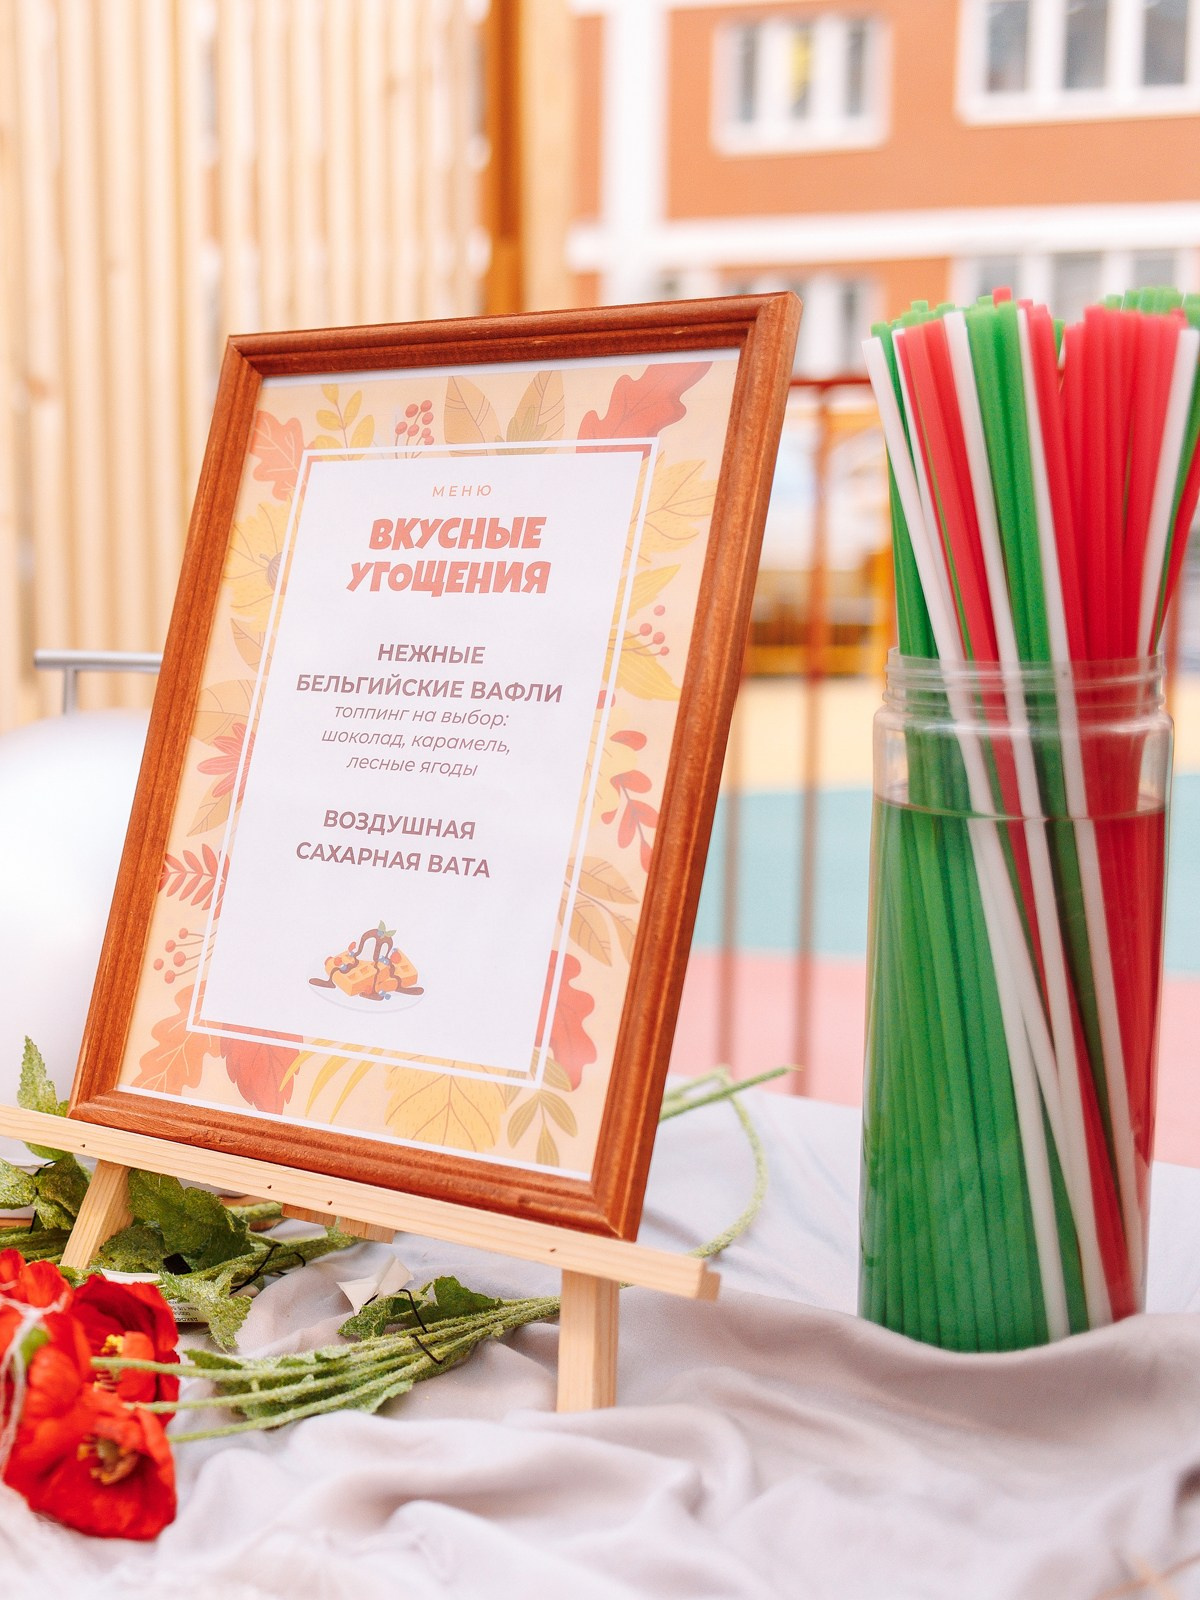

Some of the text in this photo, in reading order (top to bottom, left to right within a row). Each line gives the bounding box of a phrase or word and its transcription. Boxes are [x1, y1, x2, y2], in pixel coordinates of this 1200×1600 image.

[433, 484, 491, 497] МЕНЮ
[369, 517, 547, 550] ВКУСНЫЕ
[346, 560, 551, 597] УГОЩЕНИЯ
[378, 644, 486, 664] НЕЖНЫЕ
[296, 673, 562, 703] БЕЛЬГИЙСКИЕ ВАФЛИ
[336, 706, 509, 729] топпинг на выбор:
[322, 730, 509, 755] шоколад, карамель,
[346, 756, 478, 777] лесные ягоды
[324, 810, 475, 840] ВОЗДУШНАЯ
[296, 842, 490, 878] САХАРНАЯ ВАТА
